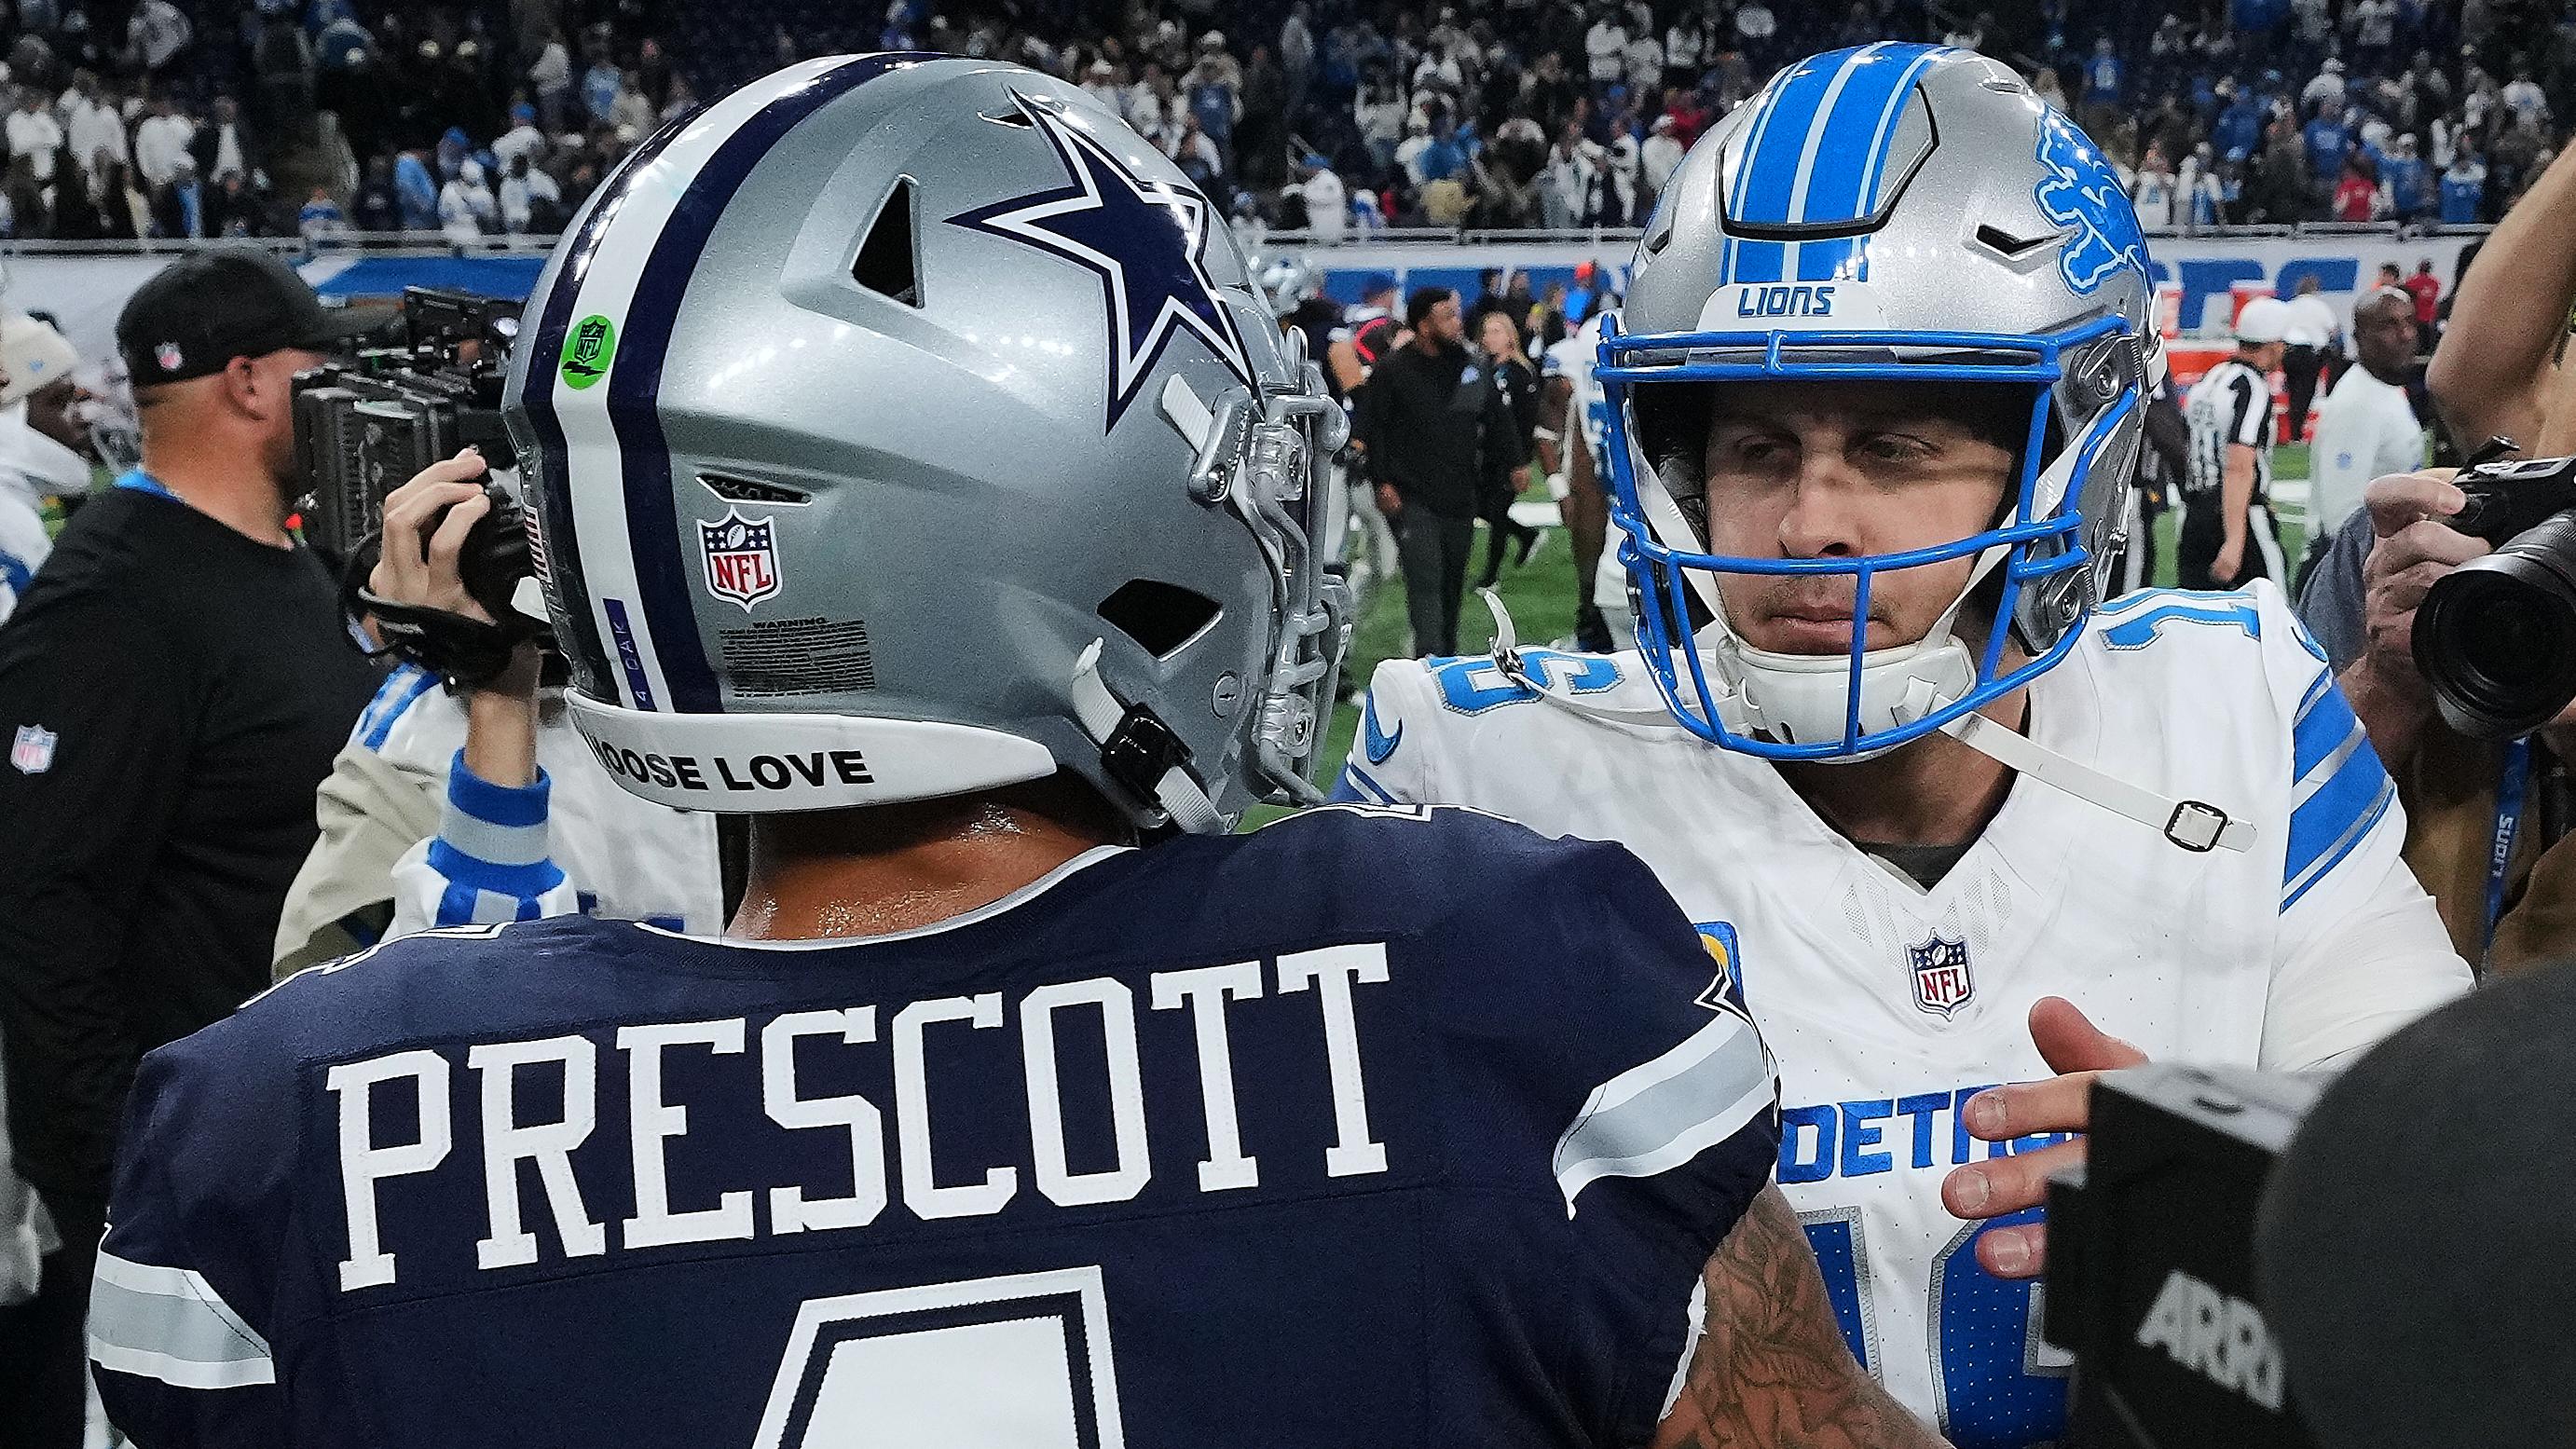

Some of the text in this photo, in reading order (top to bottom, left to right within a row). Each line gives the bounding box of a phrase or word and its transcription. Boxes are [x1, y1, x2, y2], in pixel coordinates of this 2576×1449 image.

[1738, 286, 1835, 316] LIONS
[712, 554, 772, 595] NFL
[612, 620, 639, 671] DAK
[714, 750, 875, 791] LOVE
[1921, 968, 1967, 1004] NFL
[325, 942, 1390, 1292] PRESCOTT
[2135, 1268, 2283, 1410] ARR
